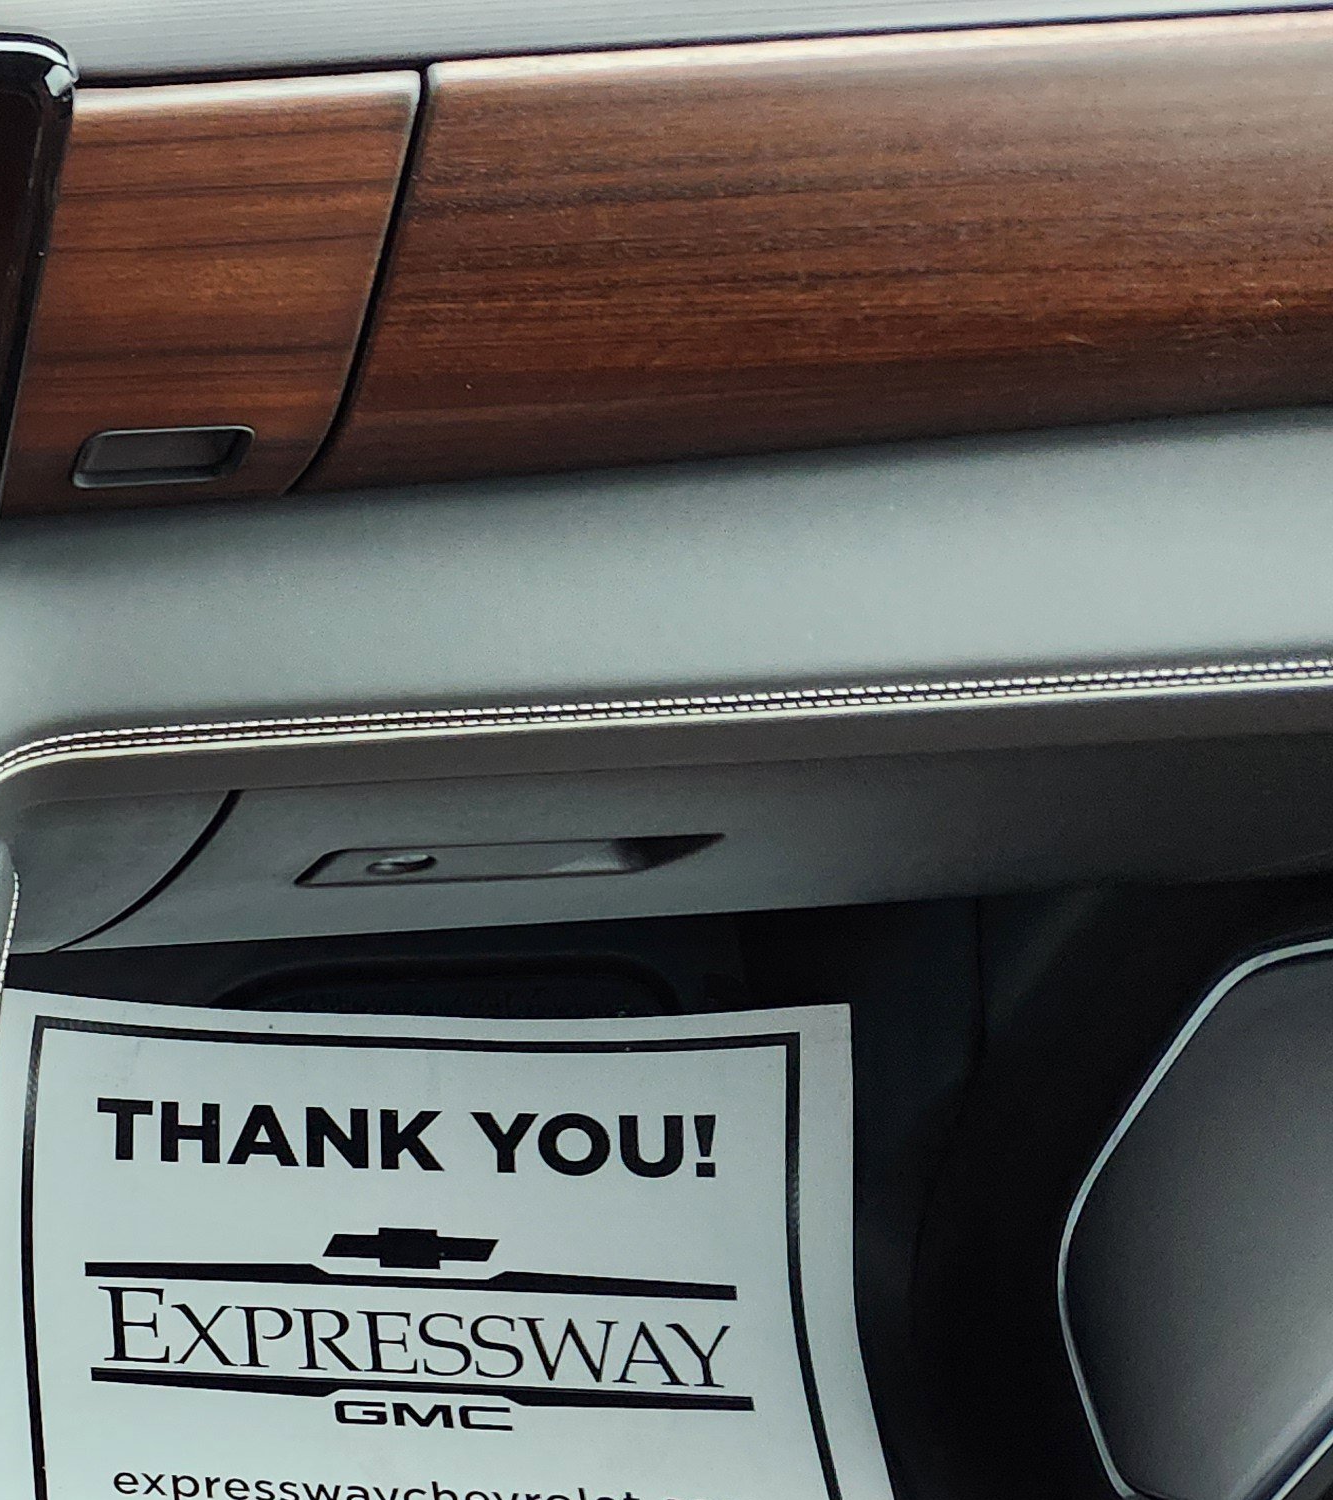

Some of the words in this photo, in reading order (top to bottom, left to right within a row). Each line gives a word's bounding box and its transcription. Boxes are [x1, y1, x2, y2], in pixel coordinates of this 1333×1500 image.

[97, 1097, 445, 1174] THANK
[471, 1111, 719, 1179] YOU!
[97, 1285, 732, 1388] EXPRESSWAY
[334, 1400, 514, 1432] GMC
